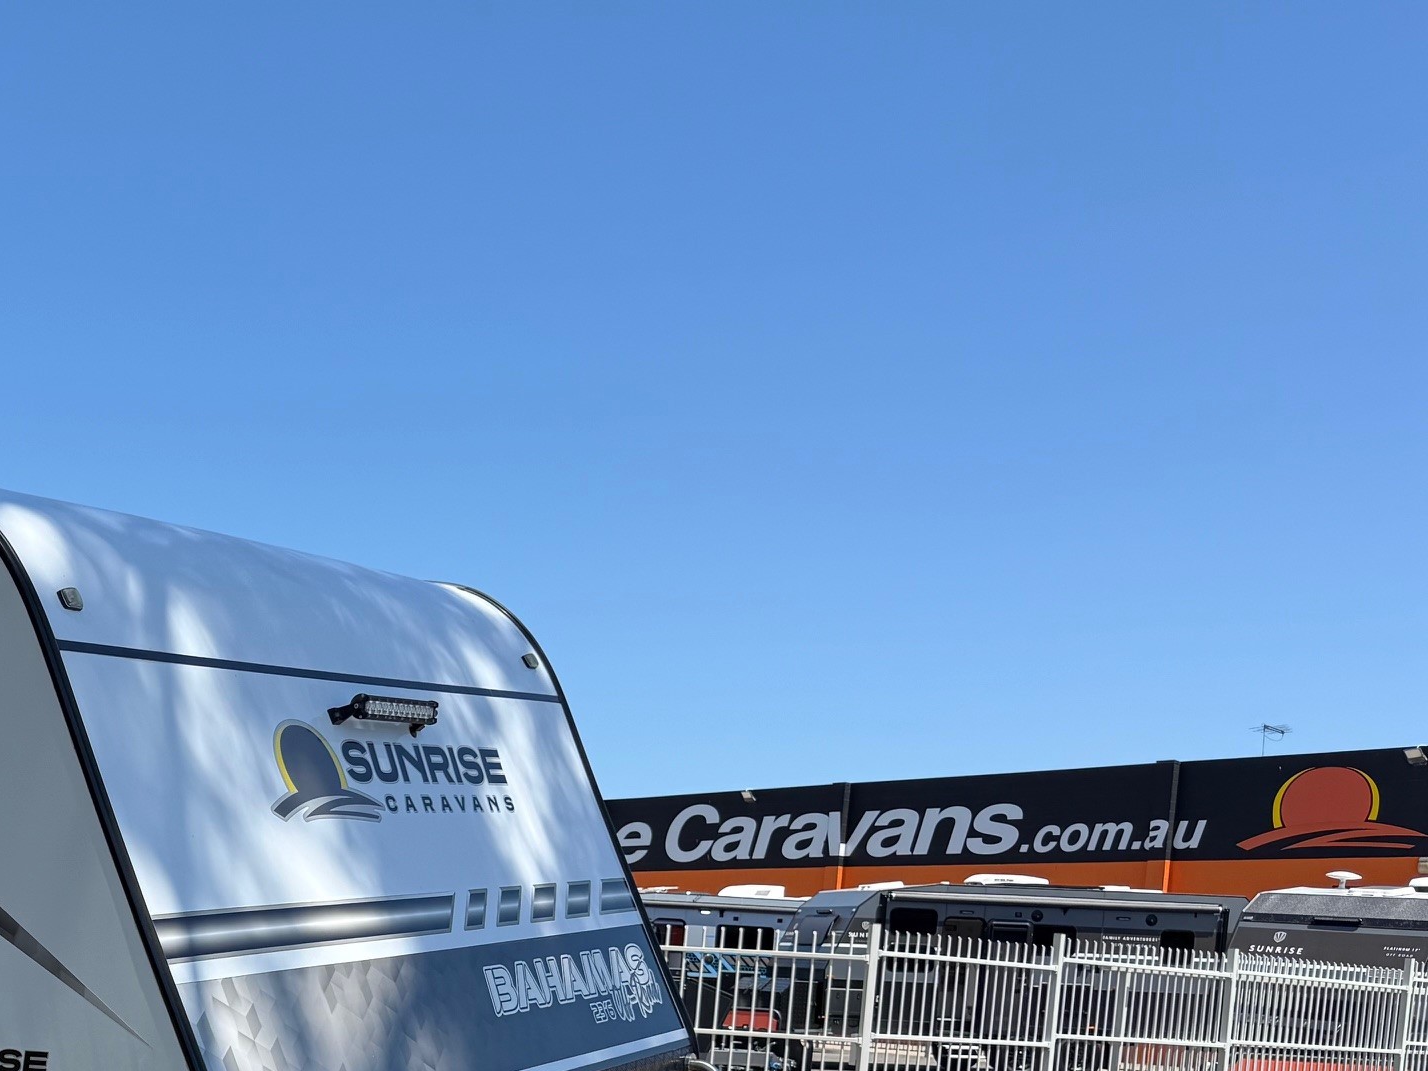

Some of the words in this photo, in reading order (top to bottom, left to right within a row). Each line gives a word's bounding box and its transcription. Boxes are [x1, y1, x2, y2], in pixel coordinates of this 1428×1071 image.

[340, 739, 508, 785] SUNRISE
[384, 793, 516, 813] CARAVANS
[1249, 944, 1303, 955] SUNRISE
[483, 943, 650, 1018] BAHAMAS
